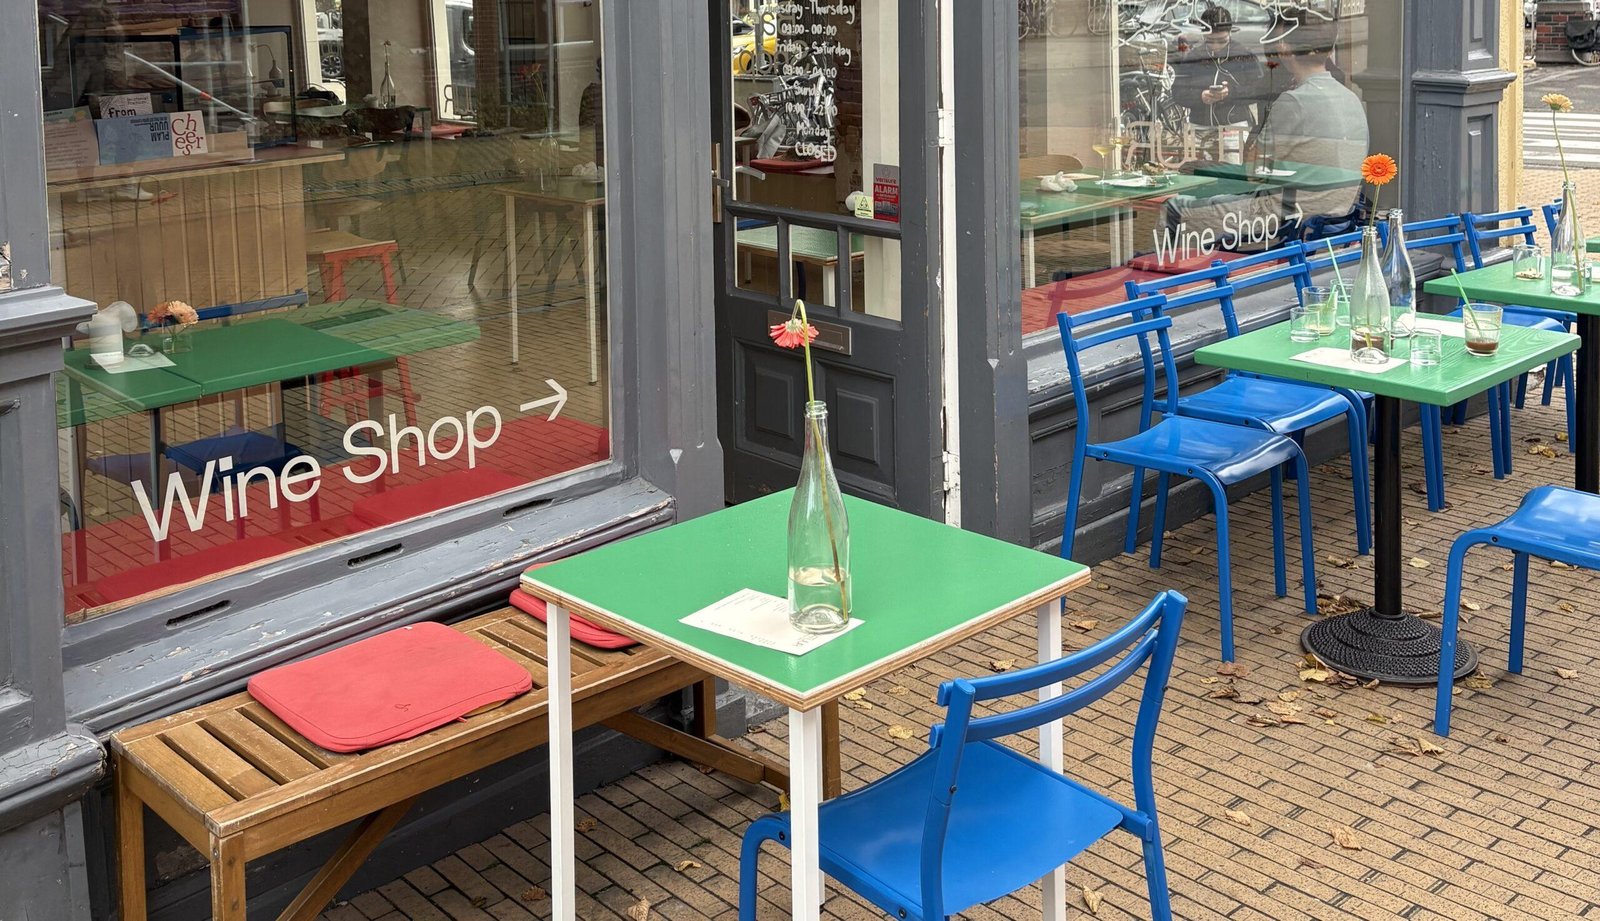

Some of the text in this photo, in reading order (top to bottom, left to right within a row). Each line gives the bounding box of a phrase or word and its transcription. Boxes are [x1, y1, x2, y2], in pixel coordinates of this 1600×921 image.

[810, 0, 855, 24] Thursday
[811, 23, 837, 36] 00:00
[811, 40, 852, 66] Saturday
[793, 80, 827, 104] Sundy
[108, 107, 137, 118] from
[812, 103, 838, 116] 220
[796, 120, 831, 144] Monday
[794, 141, 838, 162] CLOSED
[874, 184, 898, 194] ALARM
[1152, 210, 1279, 267] Wine Shop
[130, 405, 502, 542] Wine Shop
